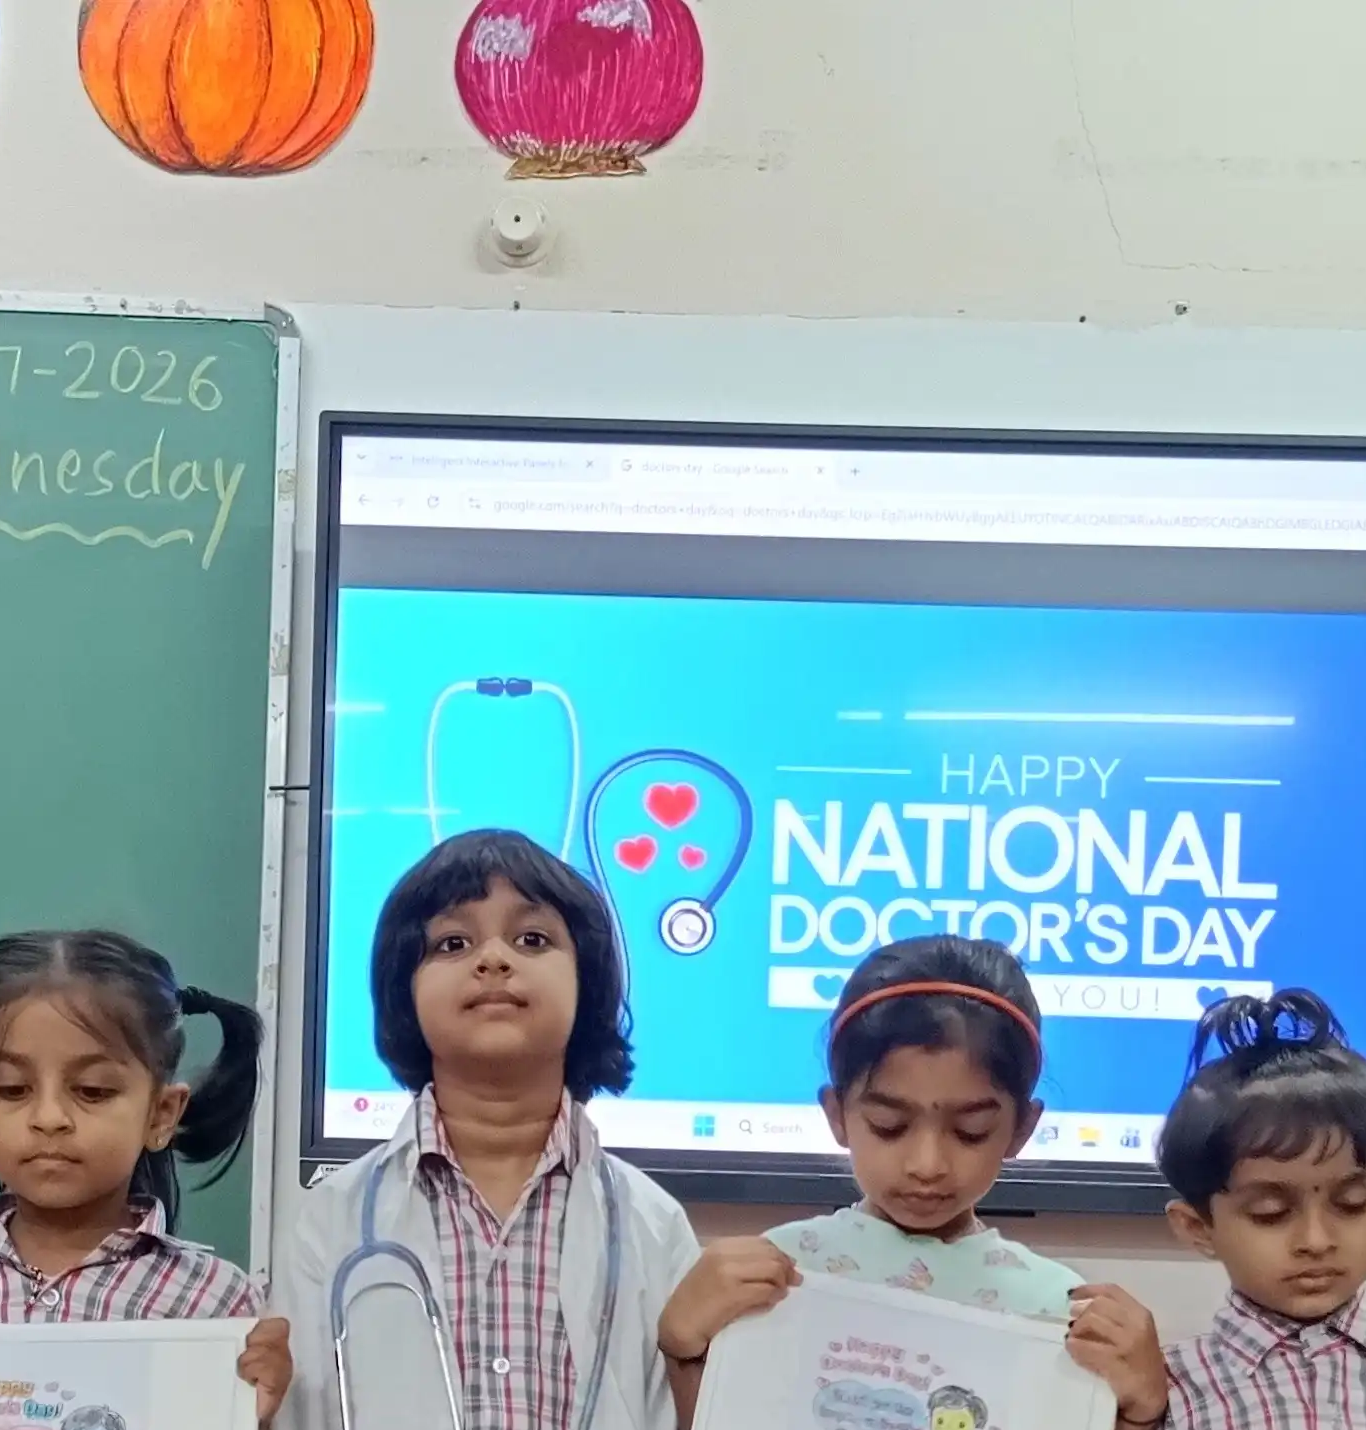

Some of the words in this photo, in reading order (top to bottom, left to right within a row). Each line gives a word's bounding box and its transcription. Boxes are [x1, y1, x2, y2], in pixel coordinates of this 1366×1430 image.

[941, 753, 1122, 798] HAPPY
[772, 799, 1278, 899] NATIONAL
[768, 893, 1129, 964] DOCTOR'S
[1142, 906, 1276, 968] DAY
[1052, 982, 1161, 1012] YOU!
[761, 1120, 803, 1134] Search
